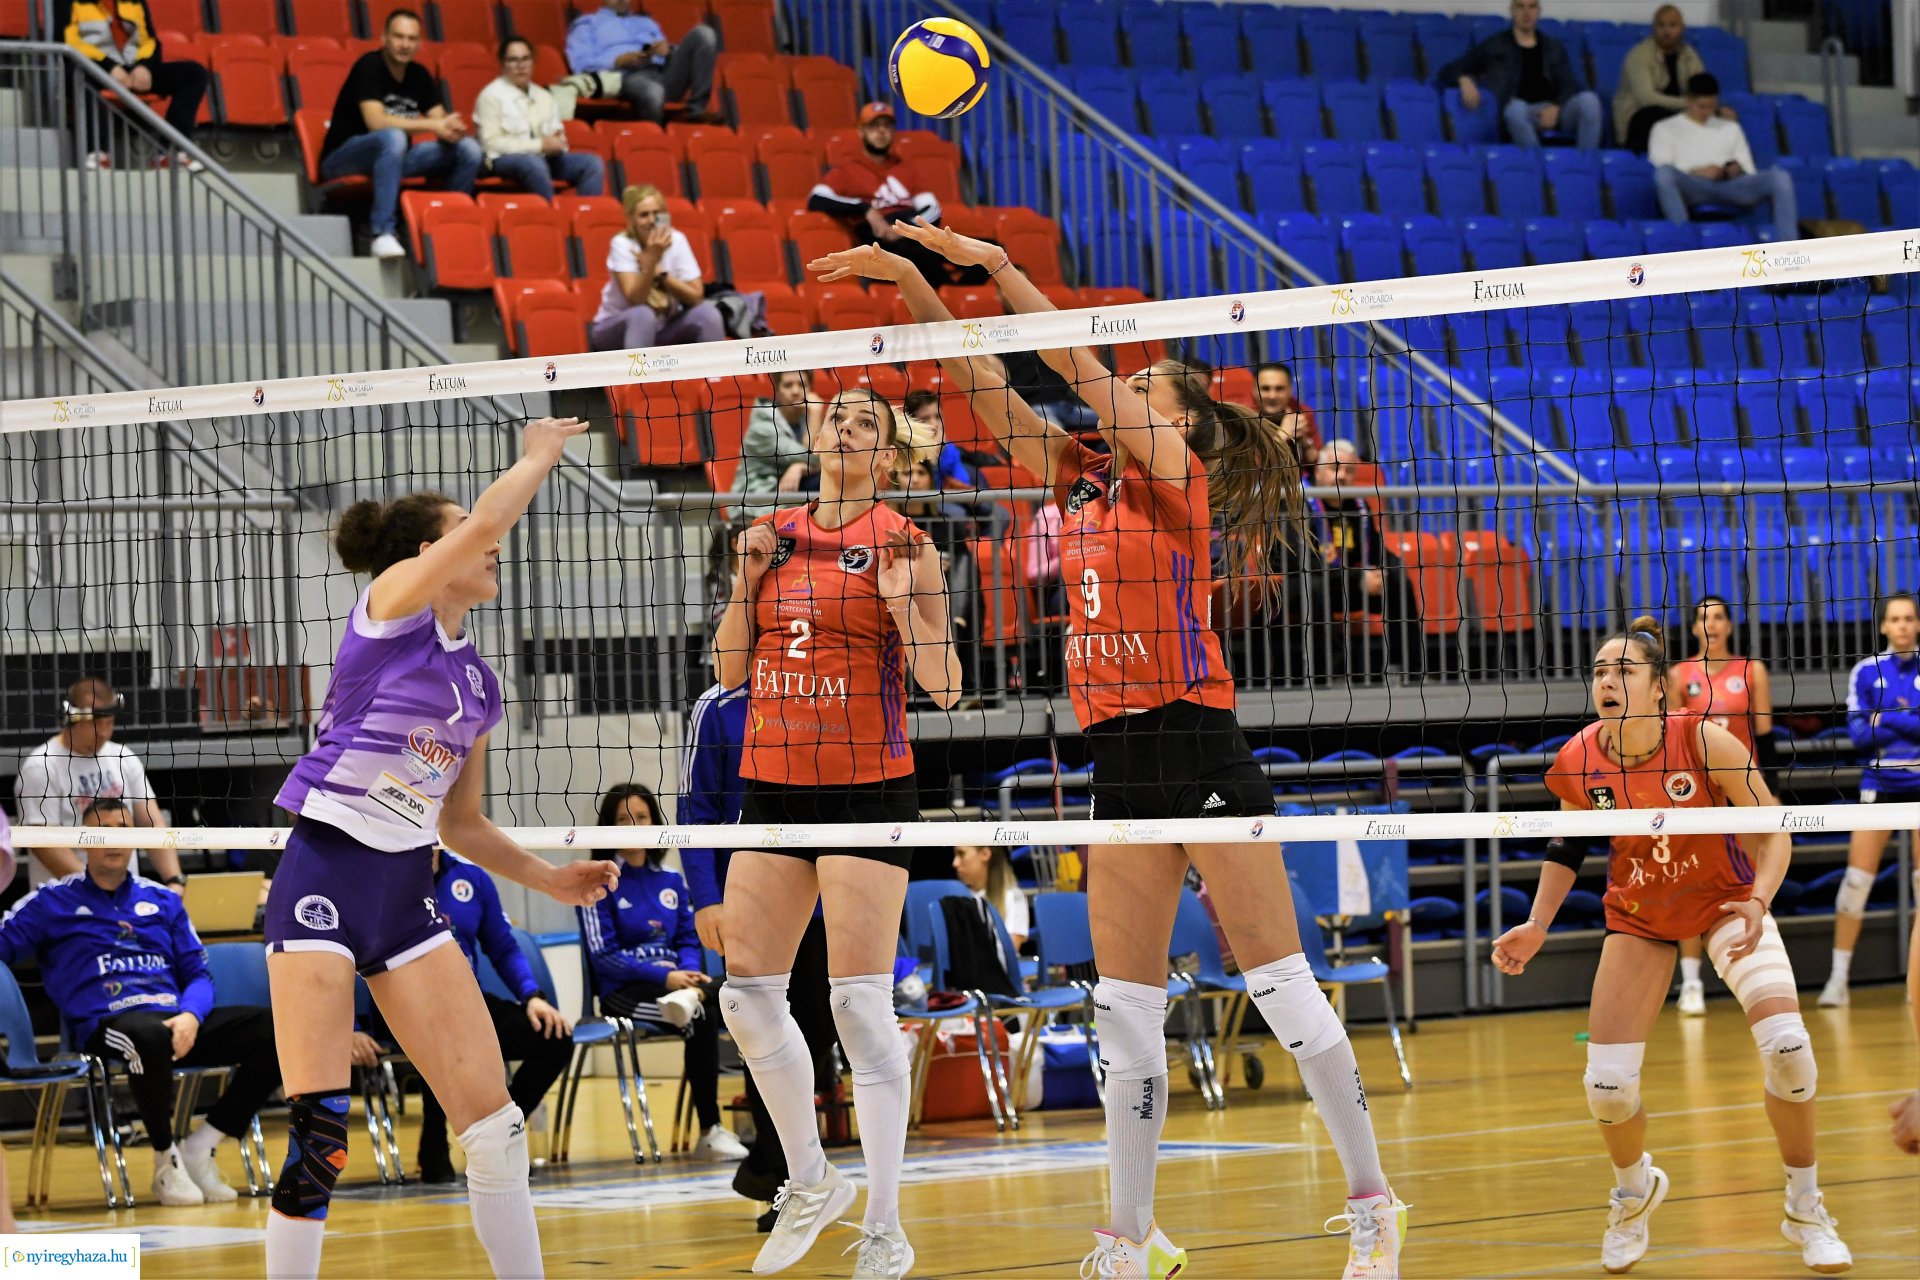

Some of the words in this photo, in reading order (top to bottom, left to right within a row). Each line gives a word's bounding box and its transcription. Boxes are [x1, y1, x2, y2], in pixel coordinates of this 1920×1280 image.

[1473, 278, 1526, 300] FATUM
[1090, 314, 1137, 334] FATUM
[745, 346, 787, 365] FATUM
[428, 373, 467, 391] FATUM
[148, 396, 183, 413] FATUM
[1081, 568, 1101, 619] 9
[787, 618, 812, 659] 2
[754, 657, 847, 700] FATUM
[1202, 800, 1227, 810] adidas
[1366, 820, 1406, 835] FATUM
[1780, 811, 1825, 827] FATUM
[657, 830, 691, 844] FATUM
[994, 827, 1030, 841] FATUM
[1652, 834, 1671, 864] 3
[1139, 1077, 1153, 1119] MIKASA
